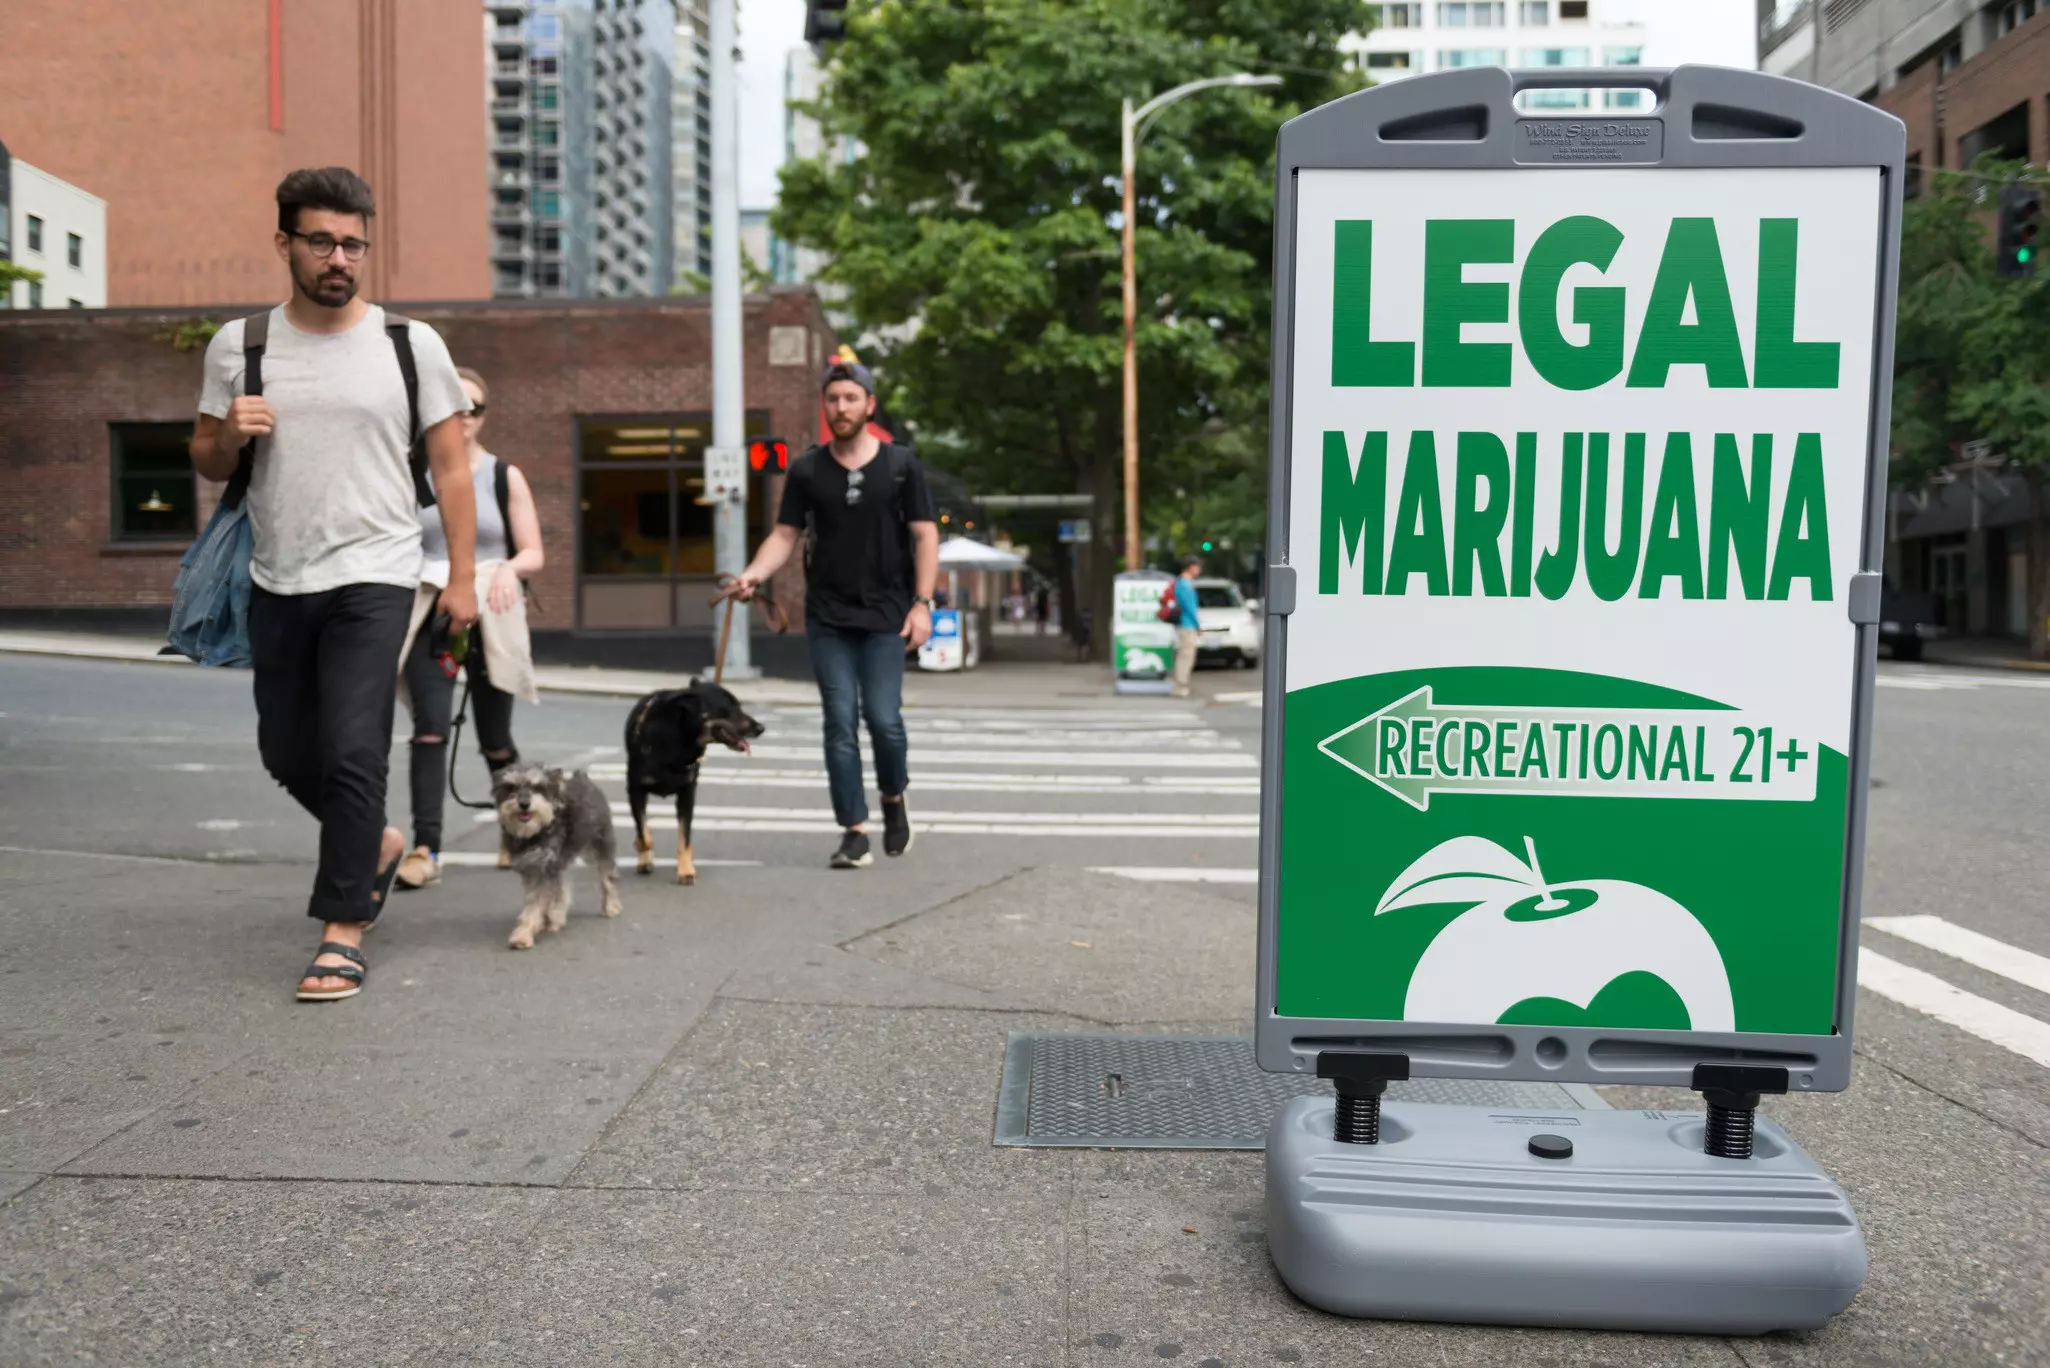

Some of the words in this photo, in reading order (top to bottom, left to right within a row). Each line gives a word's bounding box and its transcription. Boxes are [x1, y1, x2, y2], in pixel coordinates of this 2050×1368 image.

[1525, 123, 1562, 138] Wind
[1565, 124, 1600, 141] Sign
[1604, 123, 1651, 138] Deluxe
[1332, 216, 1841, 391] LEGAL
[1319, 431, 1833, 603] MARIJUANA
[1378, 719, 1715, 783] RECREATIONAL
[1730, 726, 1809, 783] 21+
